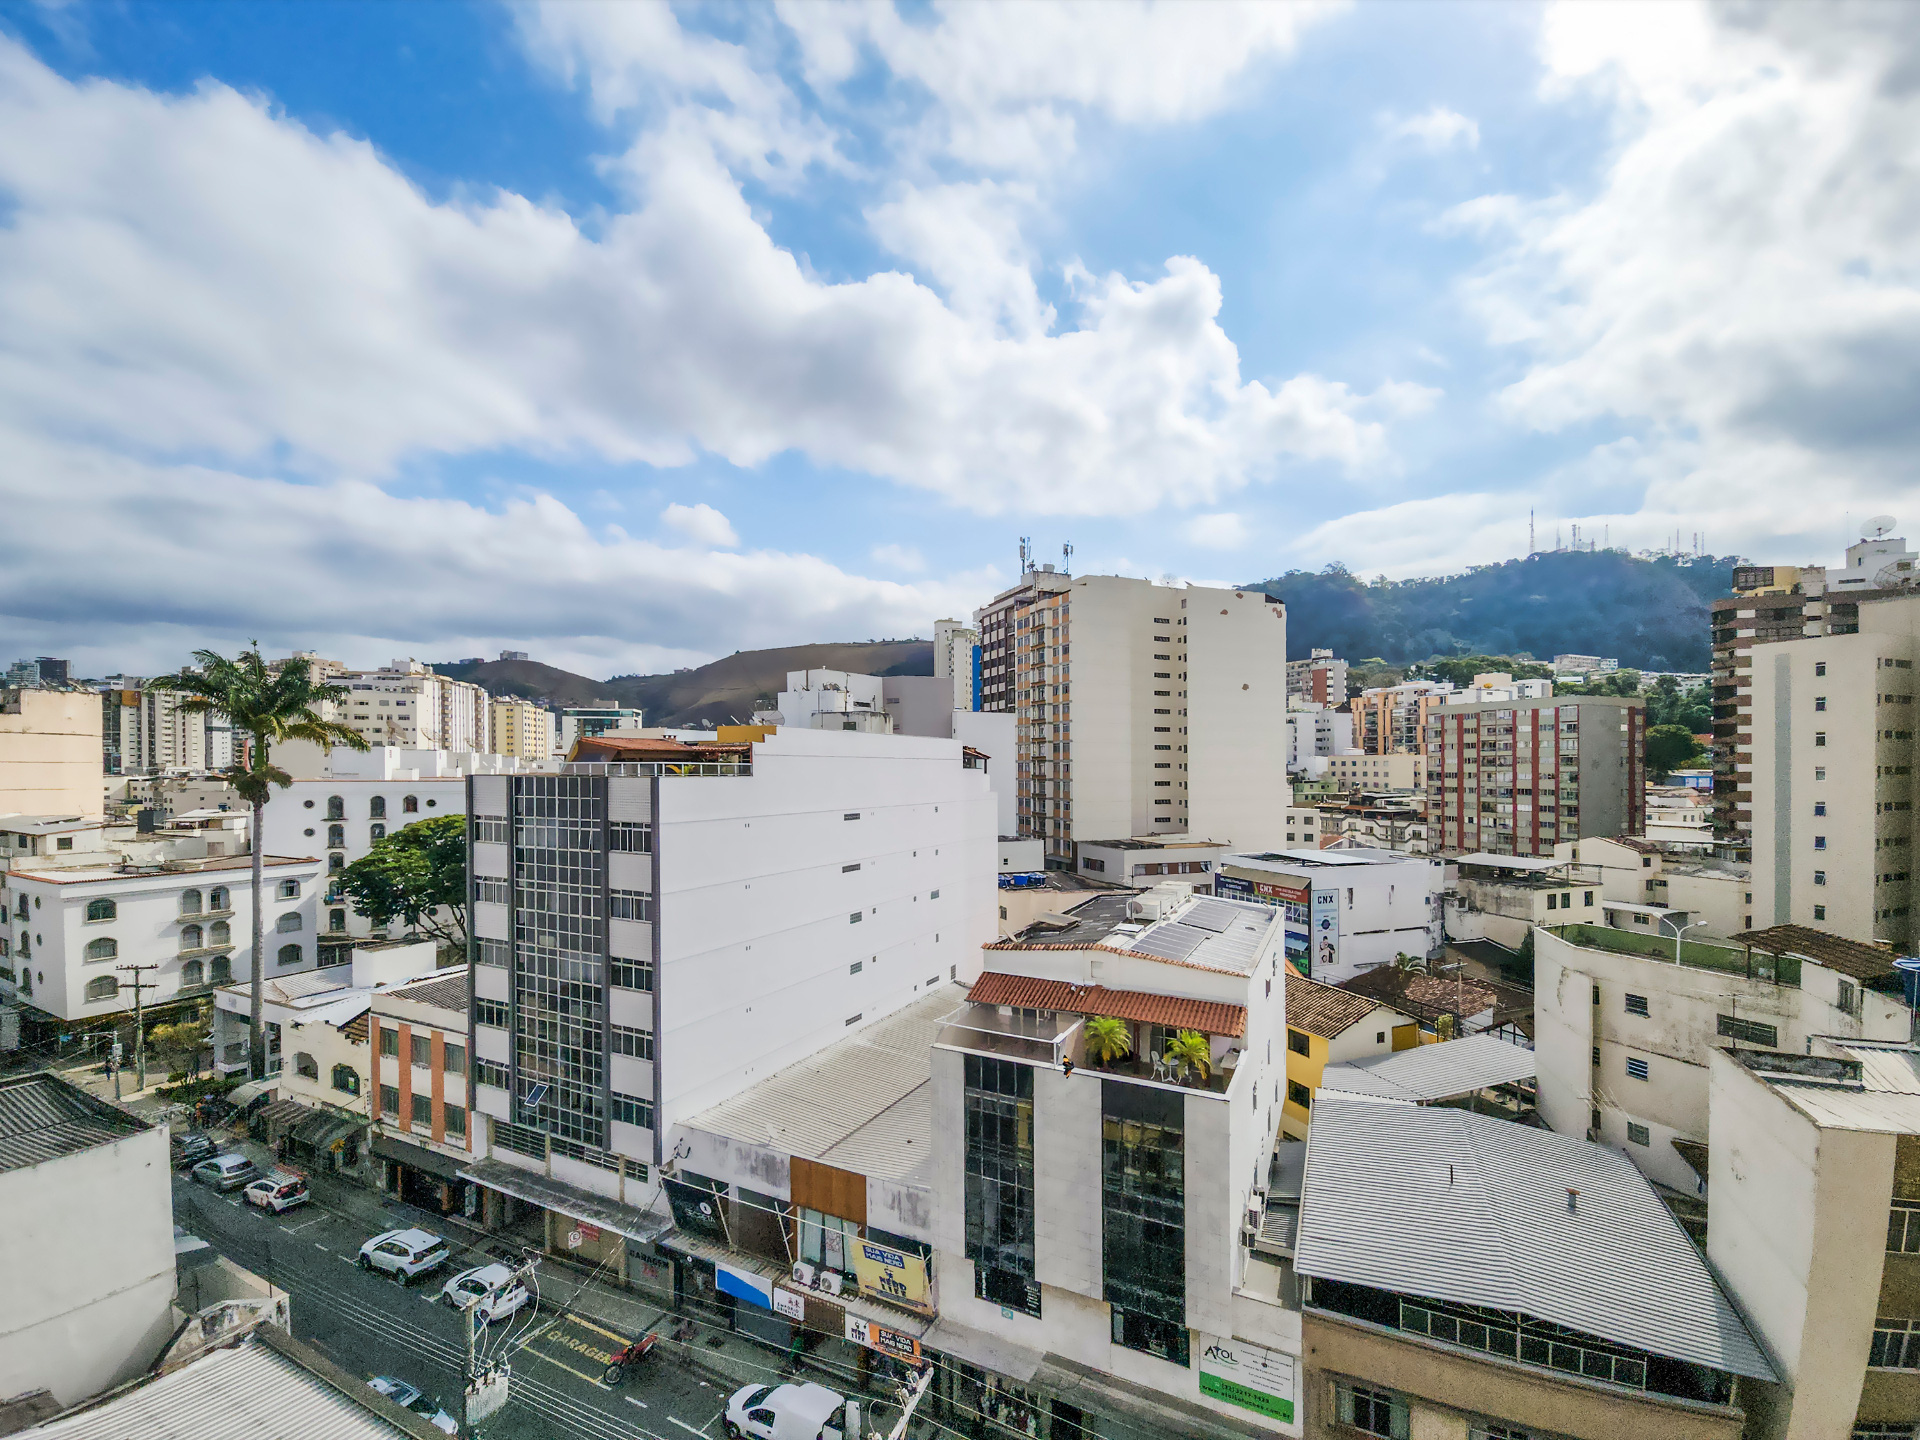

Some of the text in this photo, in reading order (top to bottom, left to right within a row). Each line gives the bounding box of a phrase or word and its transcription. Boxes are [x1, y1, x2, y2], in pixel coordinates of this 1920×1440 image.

[1259, 884, 1273, 894] CNX
[1317, 895, 1334, 905] CNX
[865, 1246, 901, 1261] SUA VIDA
[866, 1252, 903, 1268] MAIS NERD
[880, 1337, 896, 1347] MAIS
[895, 1335, 912, 1346] VIDA
[1204, 1345, 1238, 1363] ATOL
